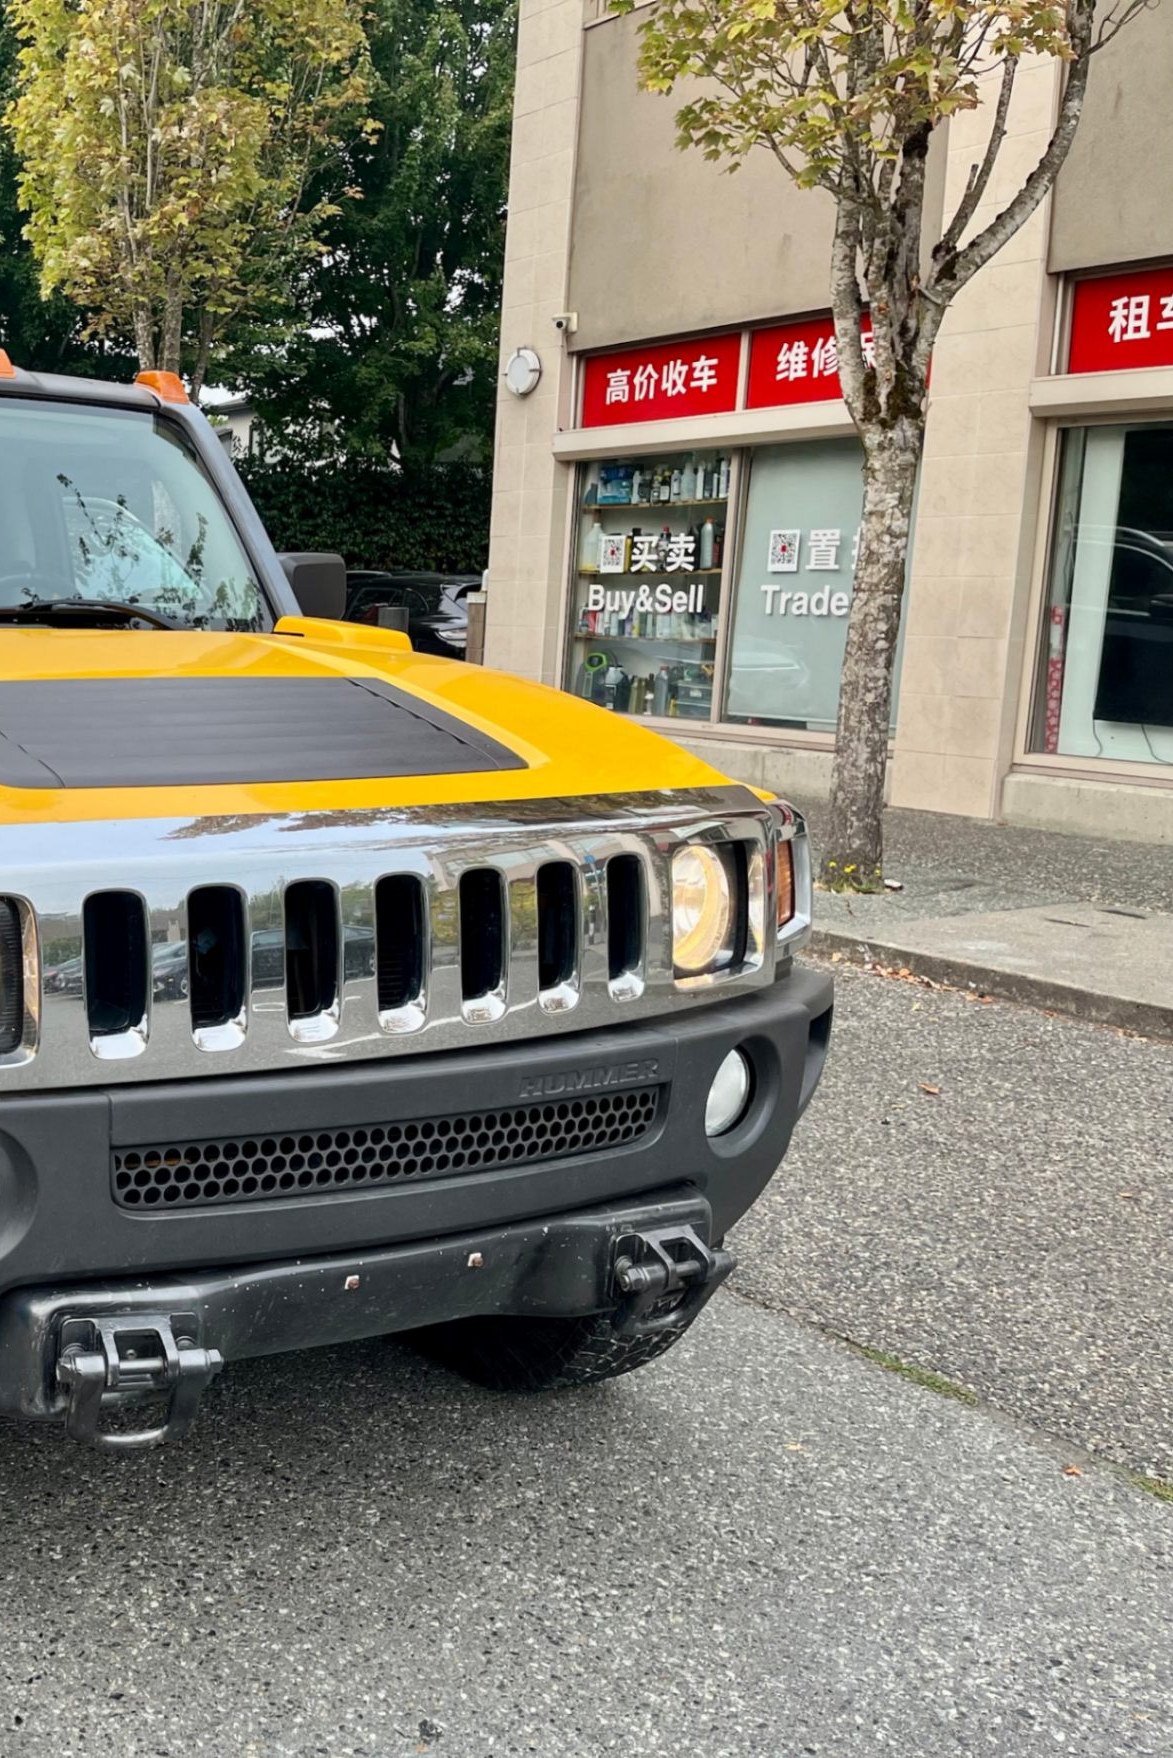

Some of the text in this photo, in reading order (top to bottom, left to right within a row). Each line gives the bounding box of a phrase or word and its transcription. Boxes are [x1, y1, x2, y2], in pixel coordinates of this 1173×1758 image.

[605, 355, 719, 405] 高价收车
[630, 533, 696, 572] 买卖
[805, 527, 862, 571] 置
[589, 584, 704, 619] Buy&Sell
[760, 584, 849, 616] Trade
[519, 1058, 659, 1098] HUMMER
